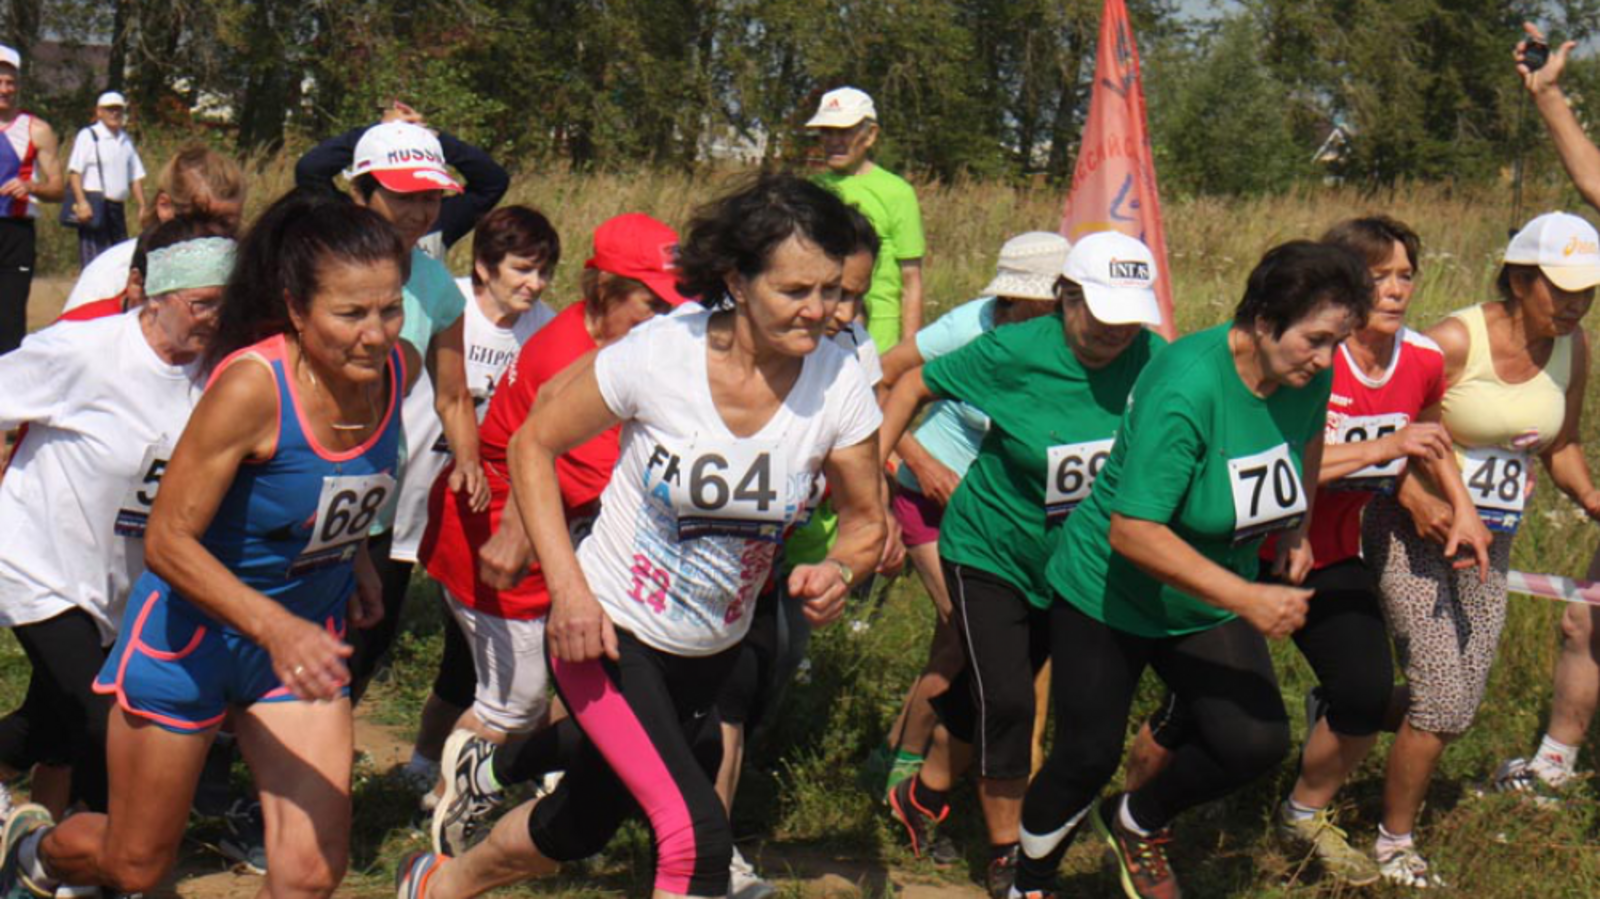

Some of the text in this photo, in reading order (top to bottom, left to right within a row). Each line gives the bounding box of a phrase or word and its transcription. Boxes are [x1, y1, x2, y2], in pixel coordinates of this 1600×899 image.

[690, 452, 777, 511] 64
[1239, 458, 1298, 518] 70
[1468, 455, 1522, 503] 48
[321, 486, 387, 542] 68
